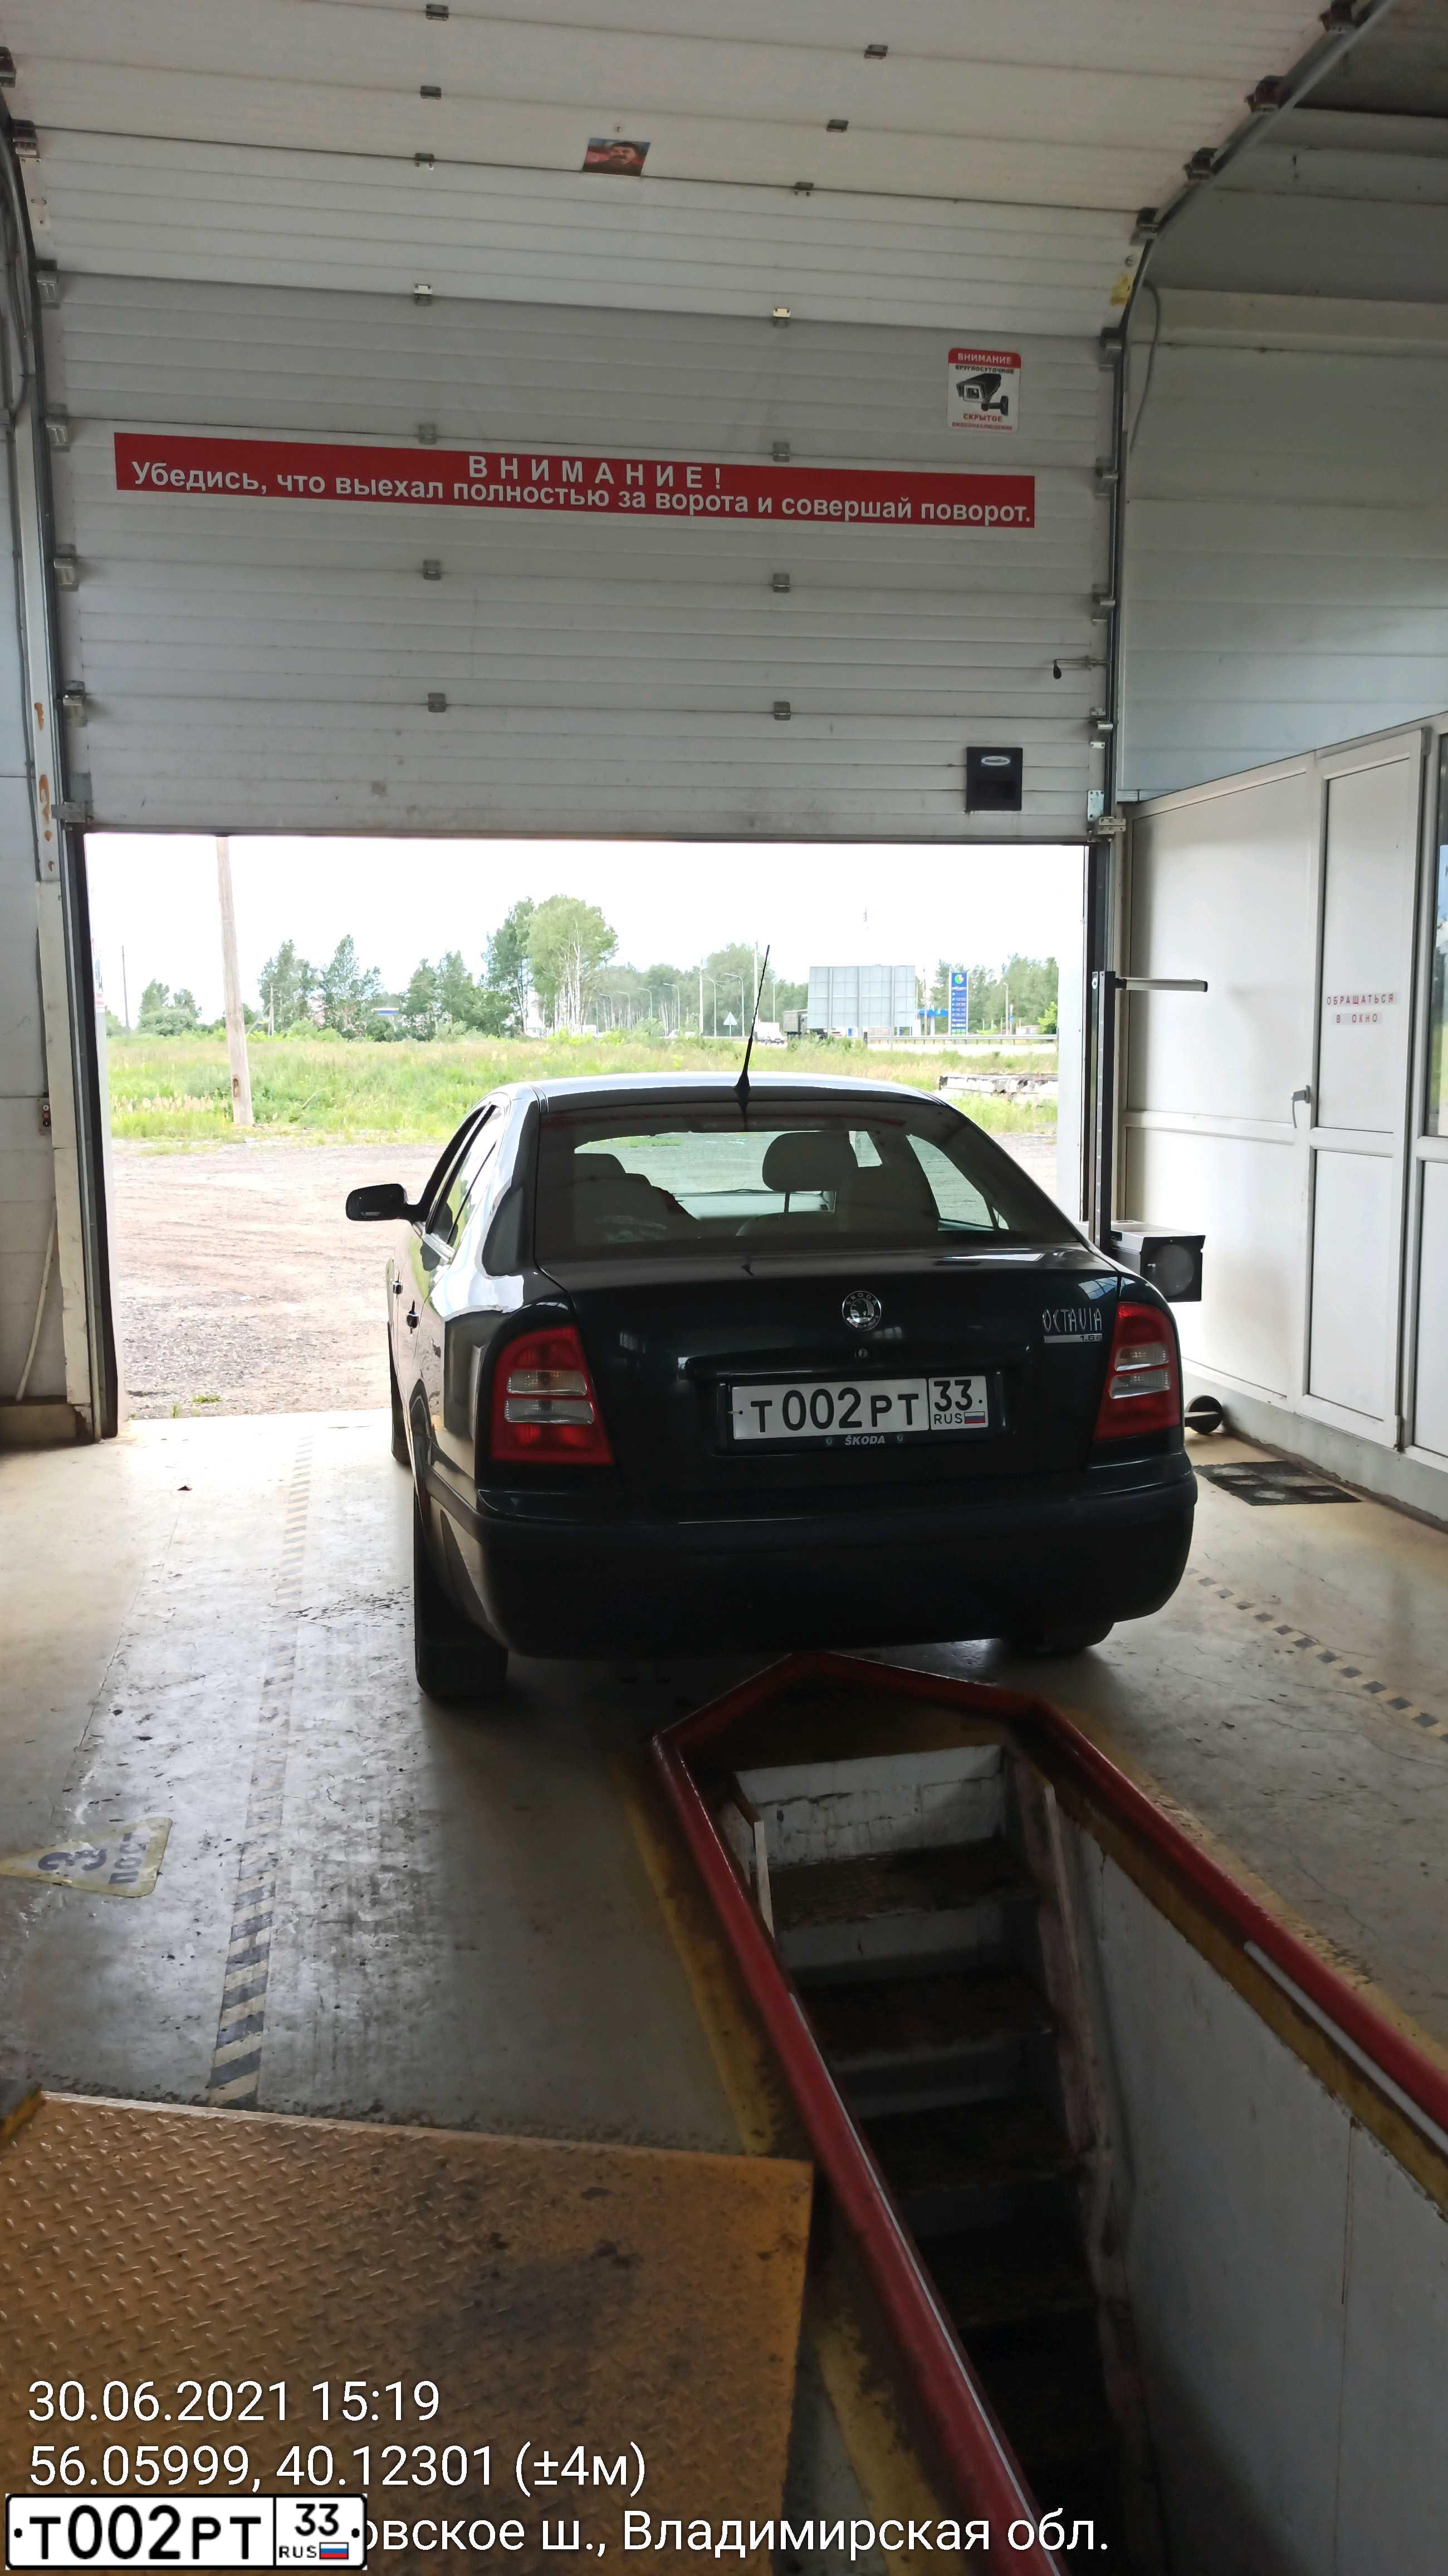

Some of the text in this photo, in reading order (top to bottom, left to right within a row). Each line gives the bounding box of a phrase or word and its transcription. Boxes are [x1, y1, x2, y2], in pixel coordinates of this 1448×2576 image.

[957, 353, 1011, 364] ВНИМАНИЕ
[963, 413, 1002, 422] СКРЫТОЕ
[131, 460, 1030, 525] Убедись, что выехал полностью за ворота и совершай поворот.
[1352, 1013, 1377, 1023] ОКНО
[1043, 1307, 1102, 1332] OCTAVIA
[934, 1379, 972, 1411] 33
[935, 1412, 962, 1424] RUS
[844, 1435, 885, 1446] ŠKODA
